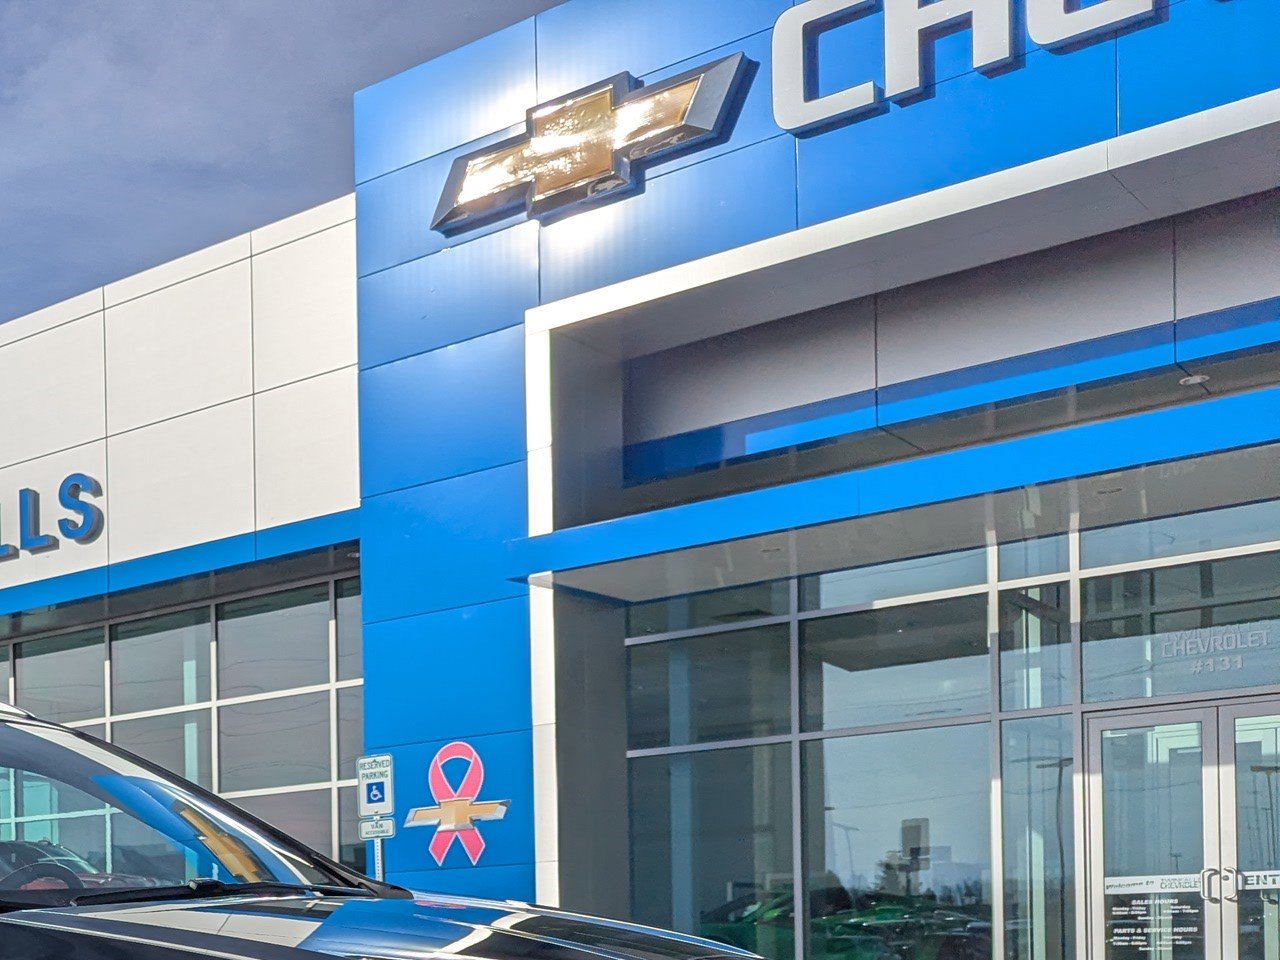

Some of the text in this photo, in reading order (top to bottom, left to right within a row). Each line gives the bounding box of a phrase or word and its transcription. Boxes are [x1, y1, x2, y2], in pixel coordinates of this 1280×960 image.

[1161, 629, 1269, 658] CHEVROLET
[1192, 654, 1243, 674] #131
[359, 759, 390, 771] RESERVED
[361, 770, 389, 780] PARKING
[370, 822, 384, 830] VAN
